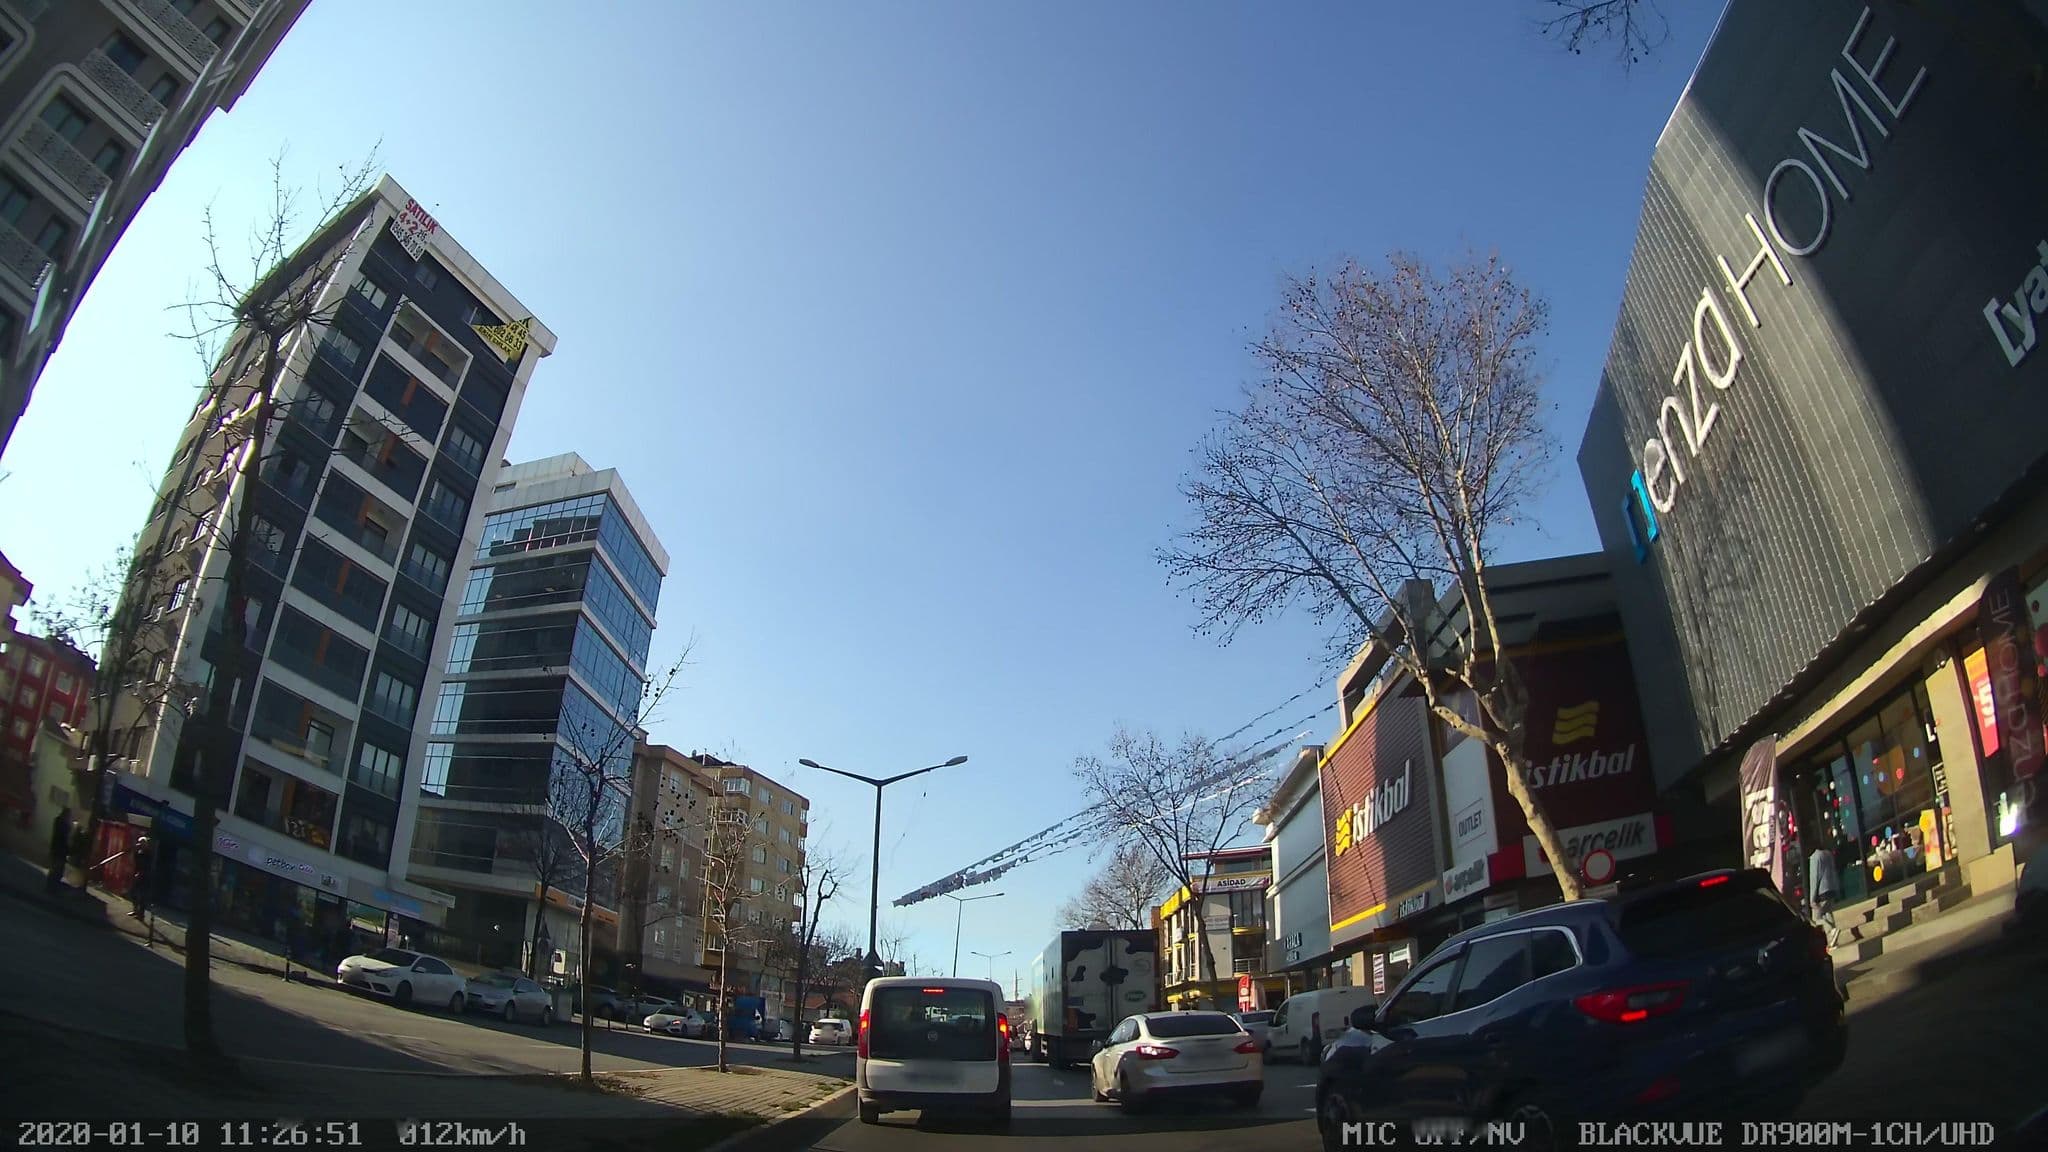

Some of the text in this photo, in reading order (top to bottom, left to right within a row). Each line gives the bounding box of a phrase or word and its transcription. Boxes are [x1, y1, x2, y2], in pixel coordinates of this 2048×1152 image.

[406, 199, 438, 235] SATILIK
[1525, 743, 1636, 789] istikbal
[1351, 758, 1411, 845] istikbal
[1457, 809, 1483, 838] OUTLET
